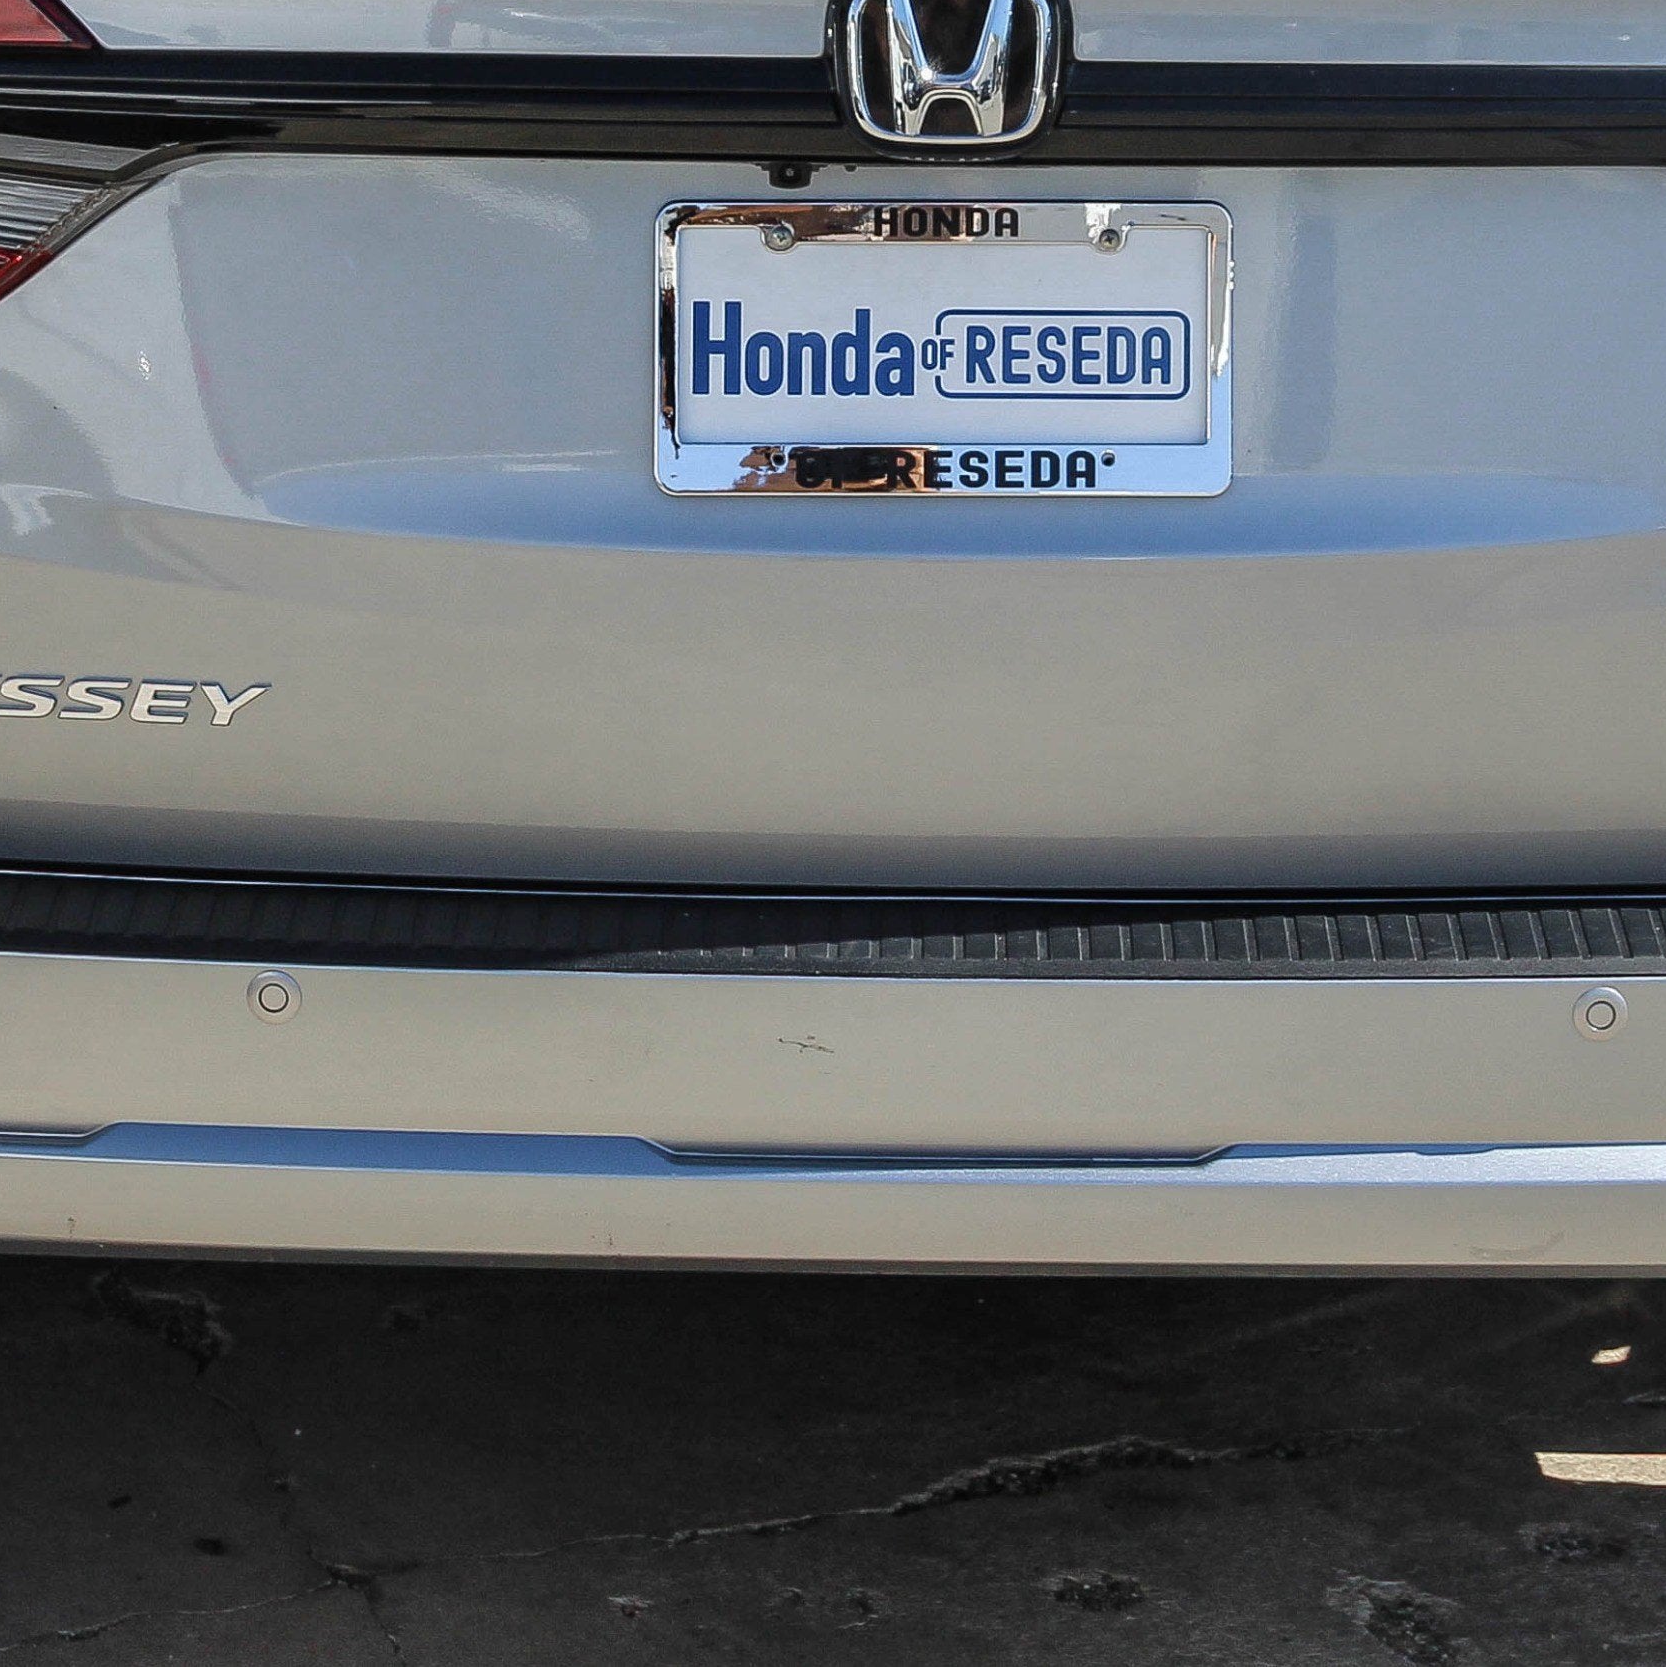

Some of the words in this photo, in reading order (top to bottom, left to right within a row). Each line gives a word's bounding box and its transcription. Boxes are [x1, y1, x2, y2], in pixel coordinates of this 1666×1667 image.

[873, 206, 1019, 237] HONDA
[691, 300, 915, 396] Honda
[922, 337, 955, 371] OF
[965, 325, 1171, 385] RESEDA
[887, 450, 1097, 489] RESEDA
